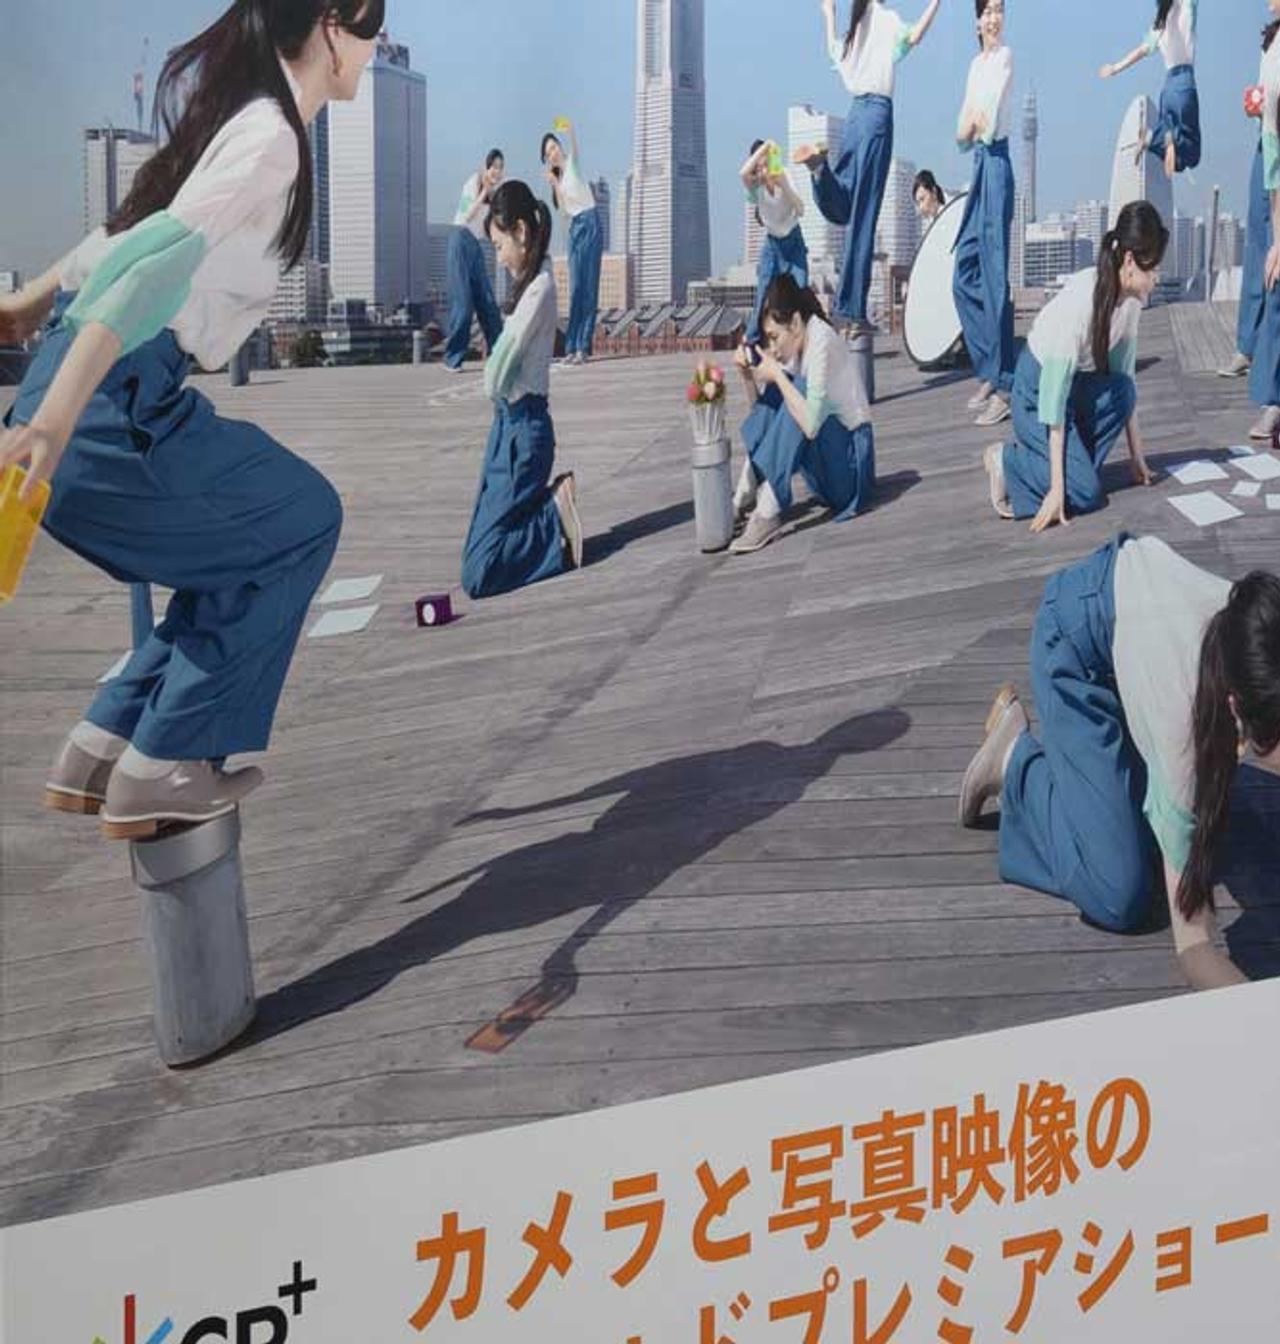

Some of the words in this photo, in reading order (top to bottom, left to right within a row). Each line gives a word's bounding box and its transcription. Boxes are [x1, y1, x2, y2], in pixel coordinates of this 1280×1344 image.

[408, 1077, 1152, 1332] カメラと写真映像の
[626, 1213, 1269, 1344] ドプレミアショー
